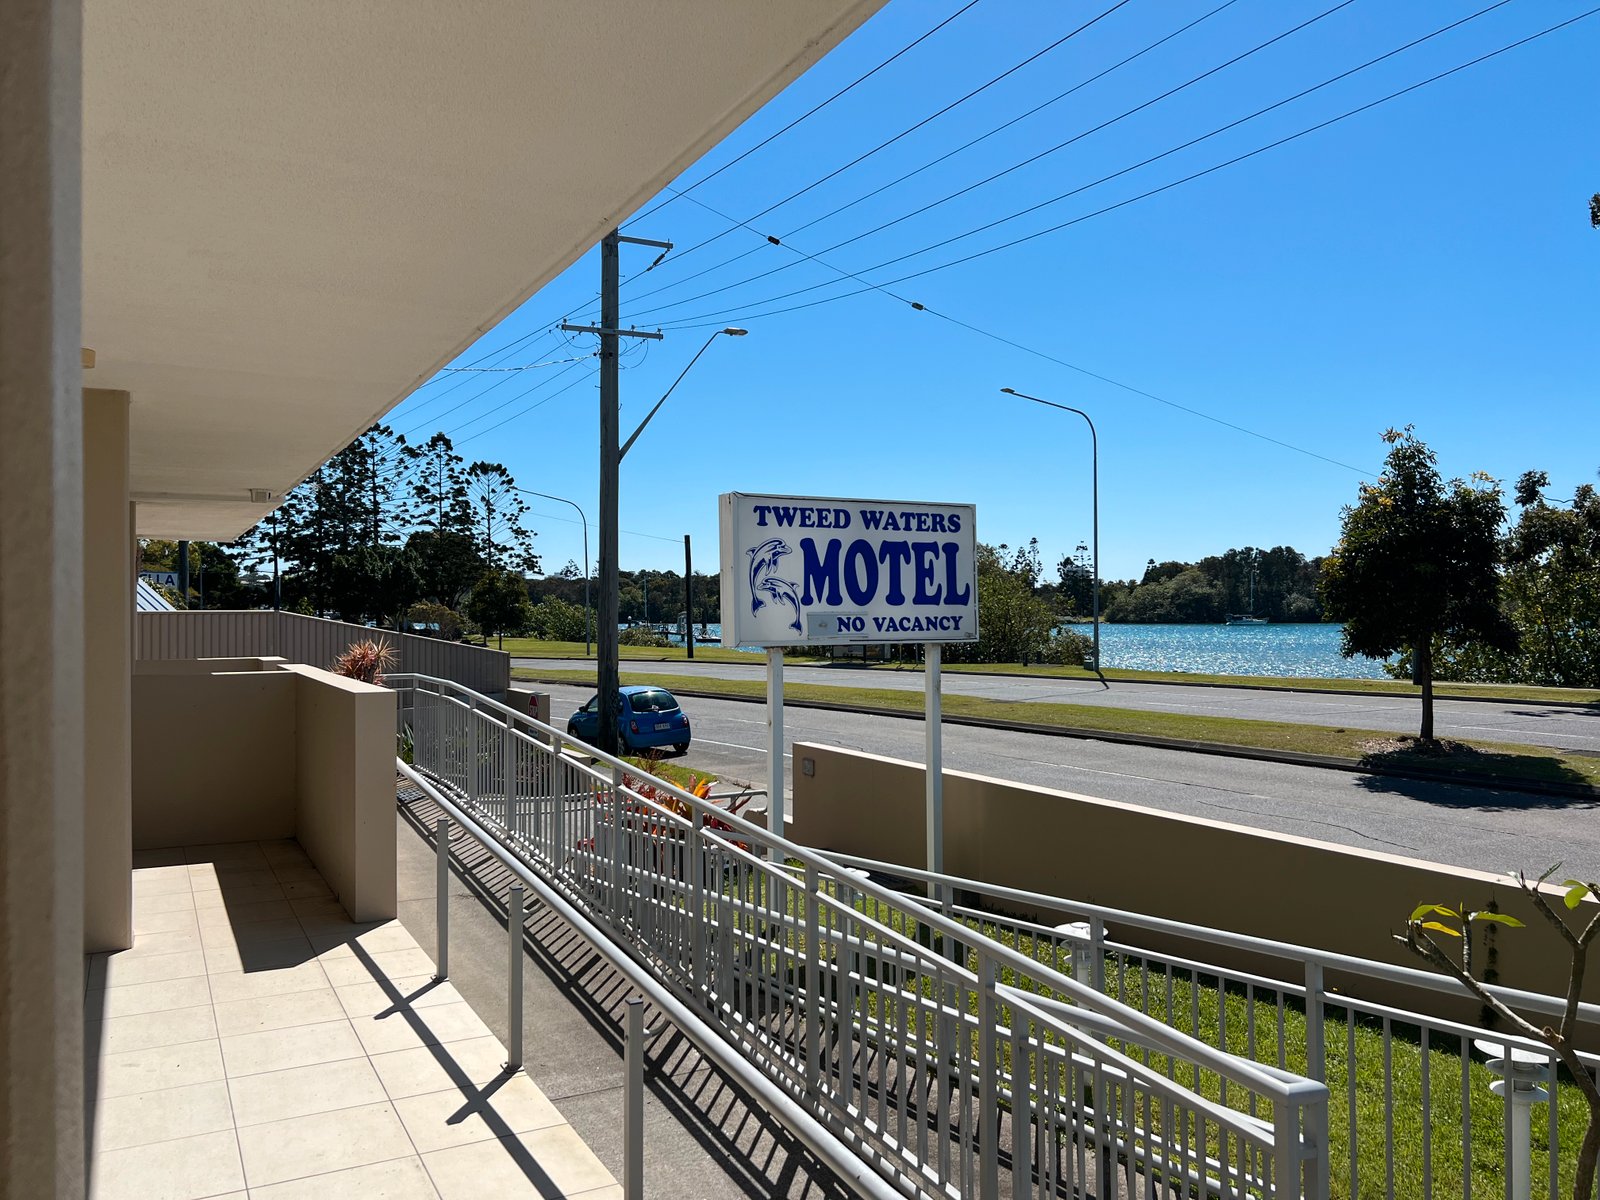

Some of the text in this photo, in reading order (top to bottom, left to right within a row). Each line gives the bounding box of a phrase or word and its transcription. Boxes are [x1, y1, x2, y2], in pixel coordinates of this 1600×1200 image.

[753, 505, 961, 533] TWEED WATERS
[800, 537, 971, 607] MOTEL
[837, 616, 963, 633] NO VACANCY
